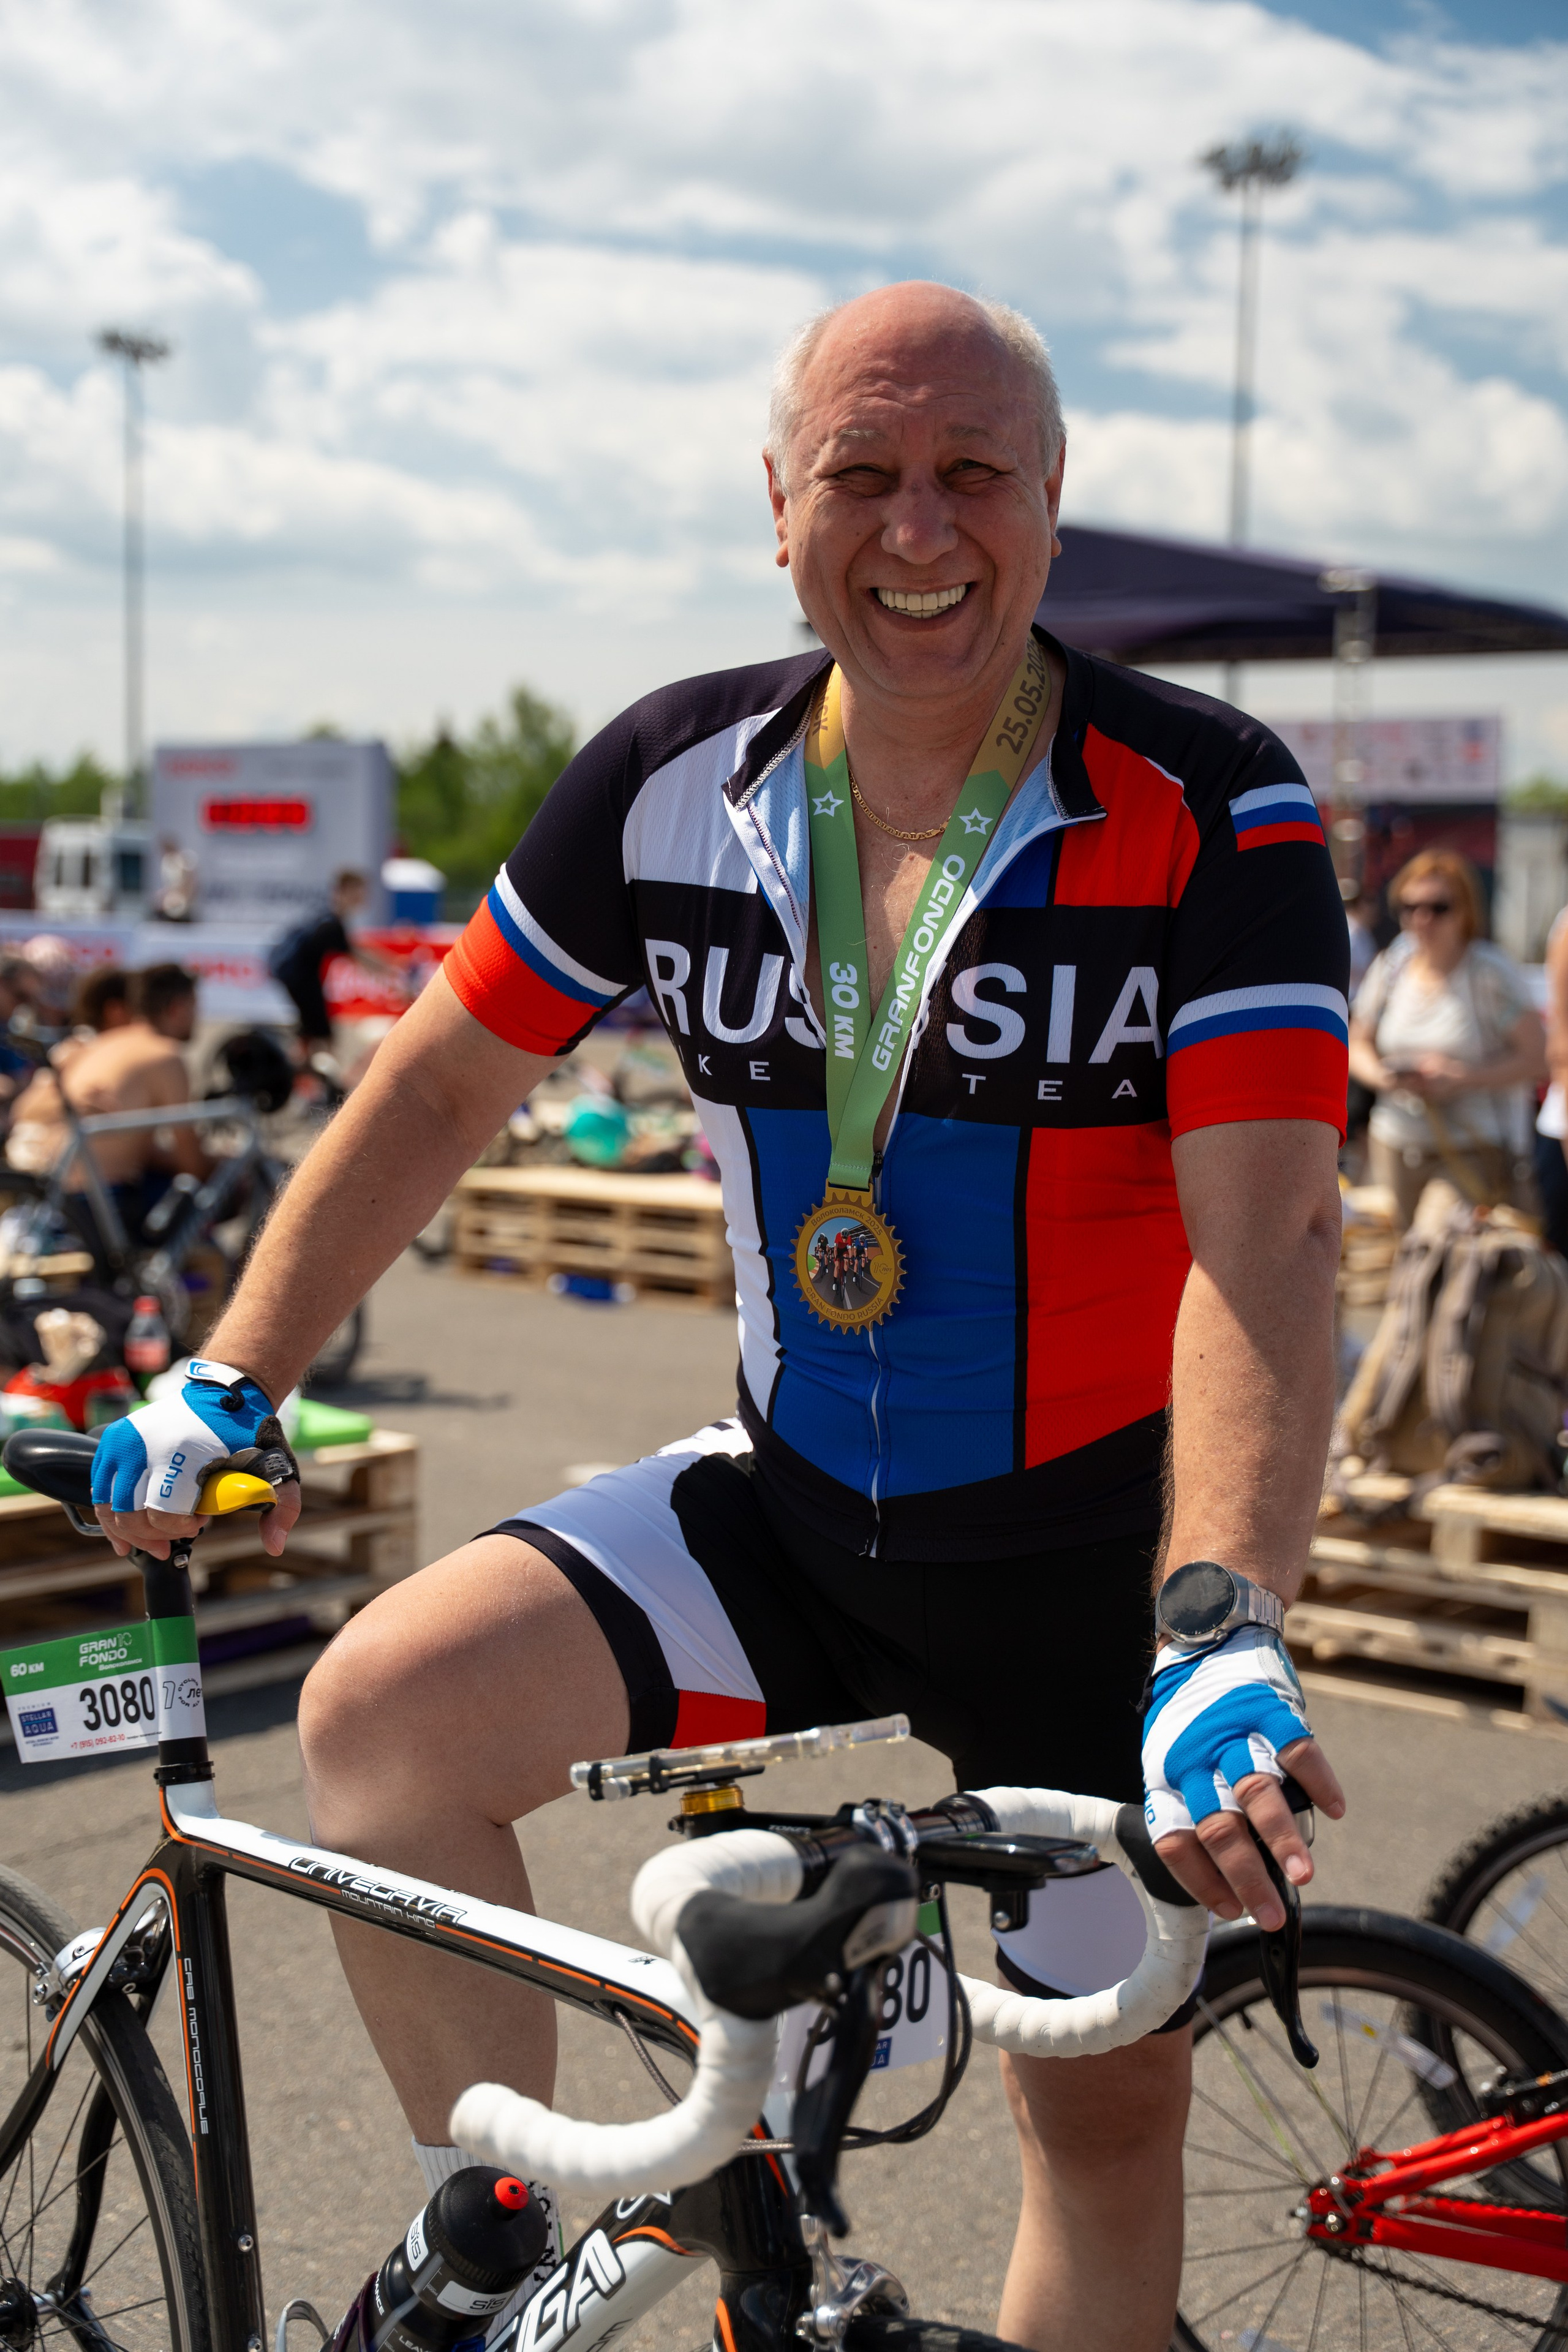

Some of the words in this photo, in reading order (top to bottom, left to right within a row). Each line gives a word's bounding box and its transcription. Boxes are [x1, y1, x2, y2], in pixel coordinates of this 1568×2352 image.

[872, 854, 966, 1071] GRANFONDO
[829, 962, 859, 1009] 30
[678, 1044, 771, 1081] IKE
[962, 1073, 1138, 1101] TEA
[811, 1207, 865, 1227] Волоколамск
[865, 1216, 883, 1237] 2025
[806, 1286, 824, 1311] GRAN
[826, 1307, 856, 1321] FONDO
[857, 1297, 884, 1319] RUSSIA
[79, 1636, 117, 1654] GRAN
[79, 1648, 127, 1667] FONDO
[10, 1662, 27, 1677] 60
[80, 1676, 156, 1731] 3080
[187, 1688, 202, 1699] ле
[24, 1722, 55, 1735] AQUA
[341, 1889, 403, 1918] MOUNTAIN
[407, 1911, 435, 1928] KING
[184, 1958, 195, 2000] CAB
[188, 2007, 209, 2135] MONOCOQUE
[469, 2296, 507, 2310] SiS
